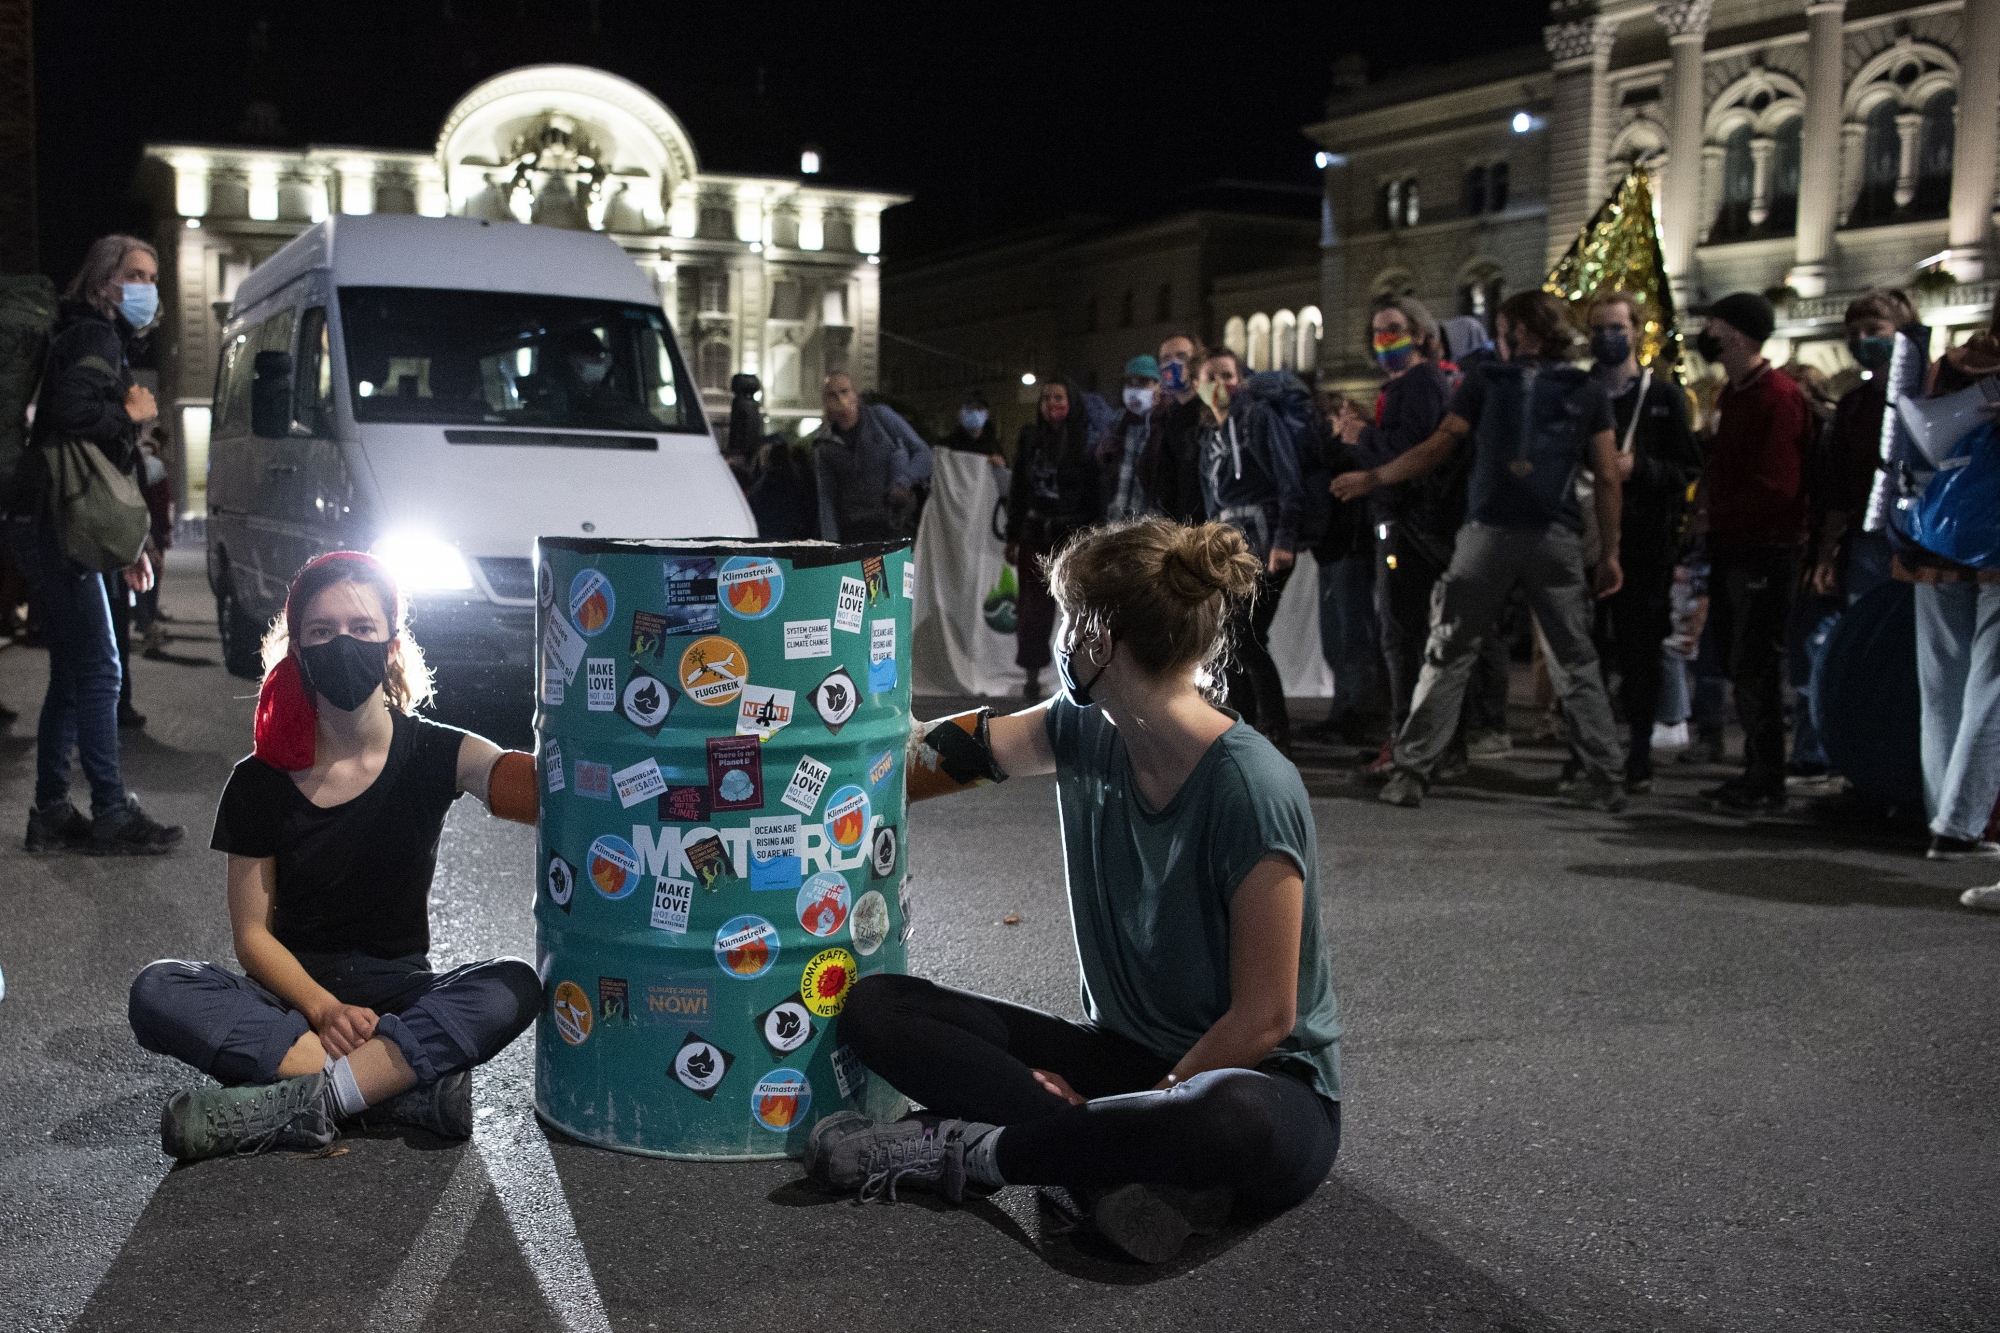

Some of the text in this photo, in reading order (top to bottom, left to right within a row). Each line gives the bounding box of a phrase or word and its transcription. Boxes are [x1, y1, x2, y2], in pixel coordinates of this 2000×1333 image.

[722, 567, 774, 582] Klimastreik
[571, 577, 600, 611] Klimastreik
[841, 582, 864, 598] MAKE
[839, 596, 862, 613] LOVE
[837, 611, 861, 622] NOT CO2
[786, 625, 828, 635] SYSTEM CHANGE
[786, 638, 829, 649] CLIMATE CHANGE
[589, 663, 614, 676] MAKE
[589, 678, 614, 690] LOVE
[694, 680, 740, 698] FLUGSTREIK
[589, 692, 614, 700] NOT CO2
[744, 703, 788, 721] NEIN!
[719, 758, 743, 766] Planet
[870, 754, 893, 785] NOW!
[798, 760, 828, 783] MAKE
[621, 775, 661, 798] ABGESAGT!
[792, 773, 821, 796] LOVE
[669, 792, 701, 802] POLITICS
[788, 786, 815, 805] NOT CO2
[669, 807, 700, 820] CLIMATE
[827, 796, 864, 819] Klimastreik
[754, 824, 797, 835] OCEANS ARE
[756, 836, 794, 847] RISING AND
[594, 843, 636, 870] Klimastreik
[756, 849, 795, 859] SO ARE WE!
[657, 881, 690, 899] MAKE
[814, 878, 838, 891] STRIKE
[813, 886, 842, 902] FUTURE
[655, 896, 688, 913] LOVE
[653, 909, 686, 922] NOT CO2
[718, 926, 767, 949] Klimastreik
[803, 950, 848, 999] ATOMKRAFT?
[648, 985, 708, 995] CLIMATE JUSTICE
[649, 994, 708, 1014] NOW!
[816, 1002, 841, 1015] NEIN
[557, 1015, 581, 1040] FLUGSTREIK
[759, 1085, 806, 1093] Klimastreik
